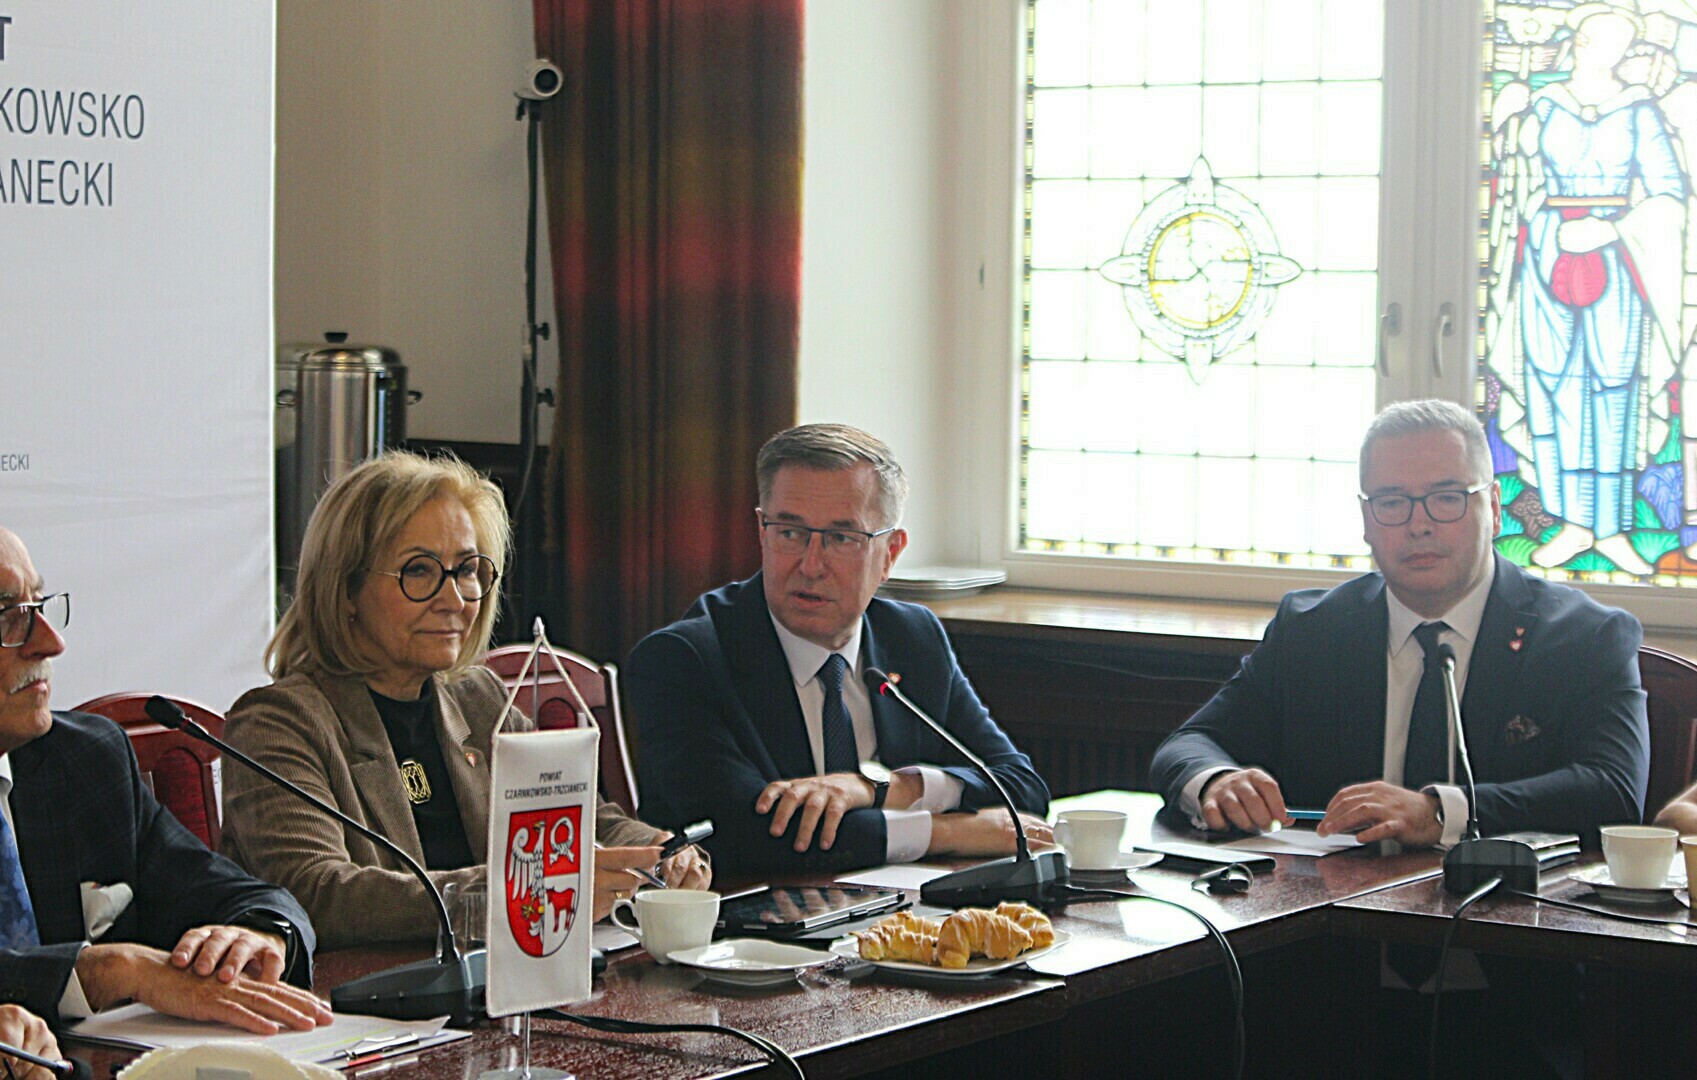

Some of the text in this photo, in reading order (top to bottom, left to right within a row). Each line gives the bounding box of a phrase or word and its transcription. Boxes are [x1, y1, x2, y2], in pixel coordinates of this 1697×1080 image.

[1, 454, 29, 471] ECKI
[539, 771, 562, 783] POWIAT
[504, 782, 588, 800] CZARNKOWSKO-TRZCIANECKI
